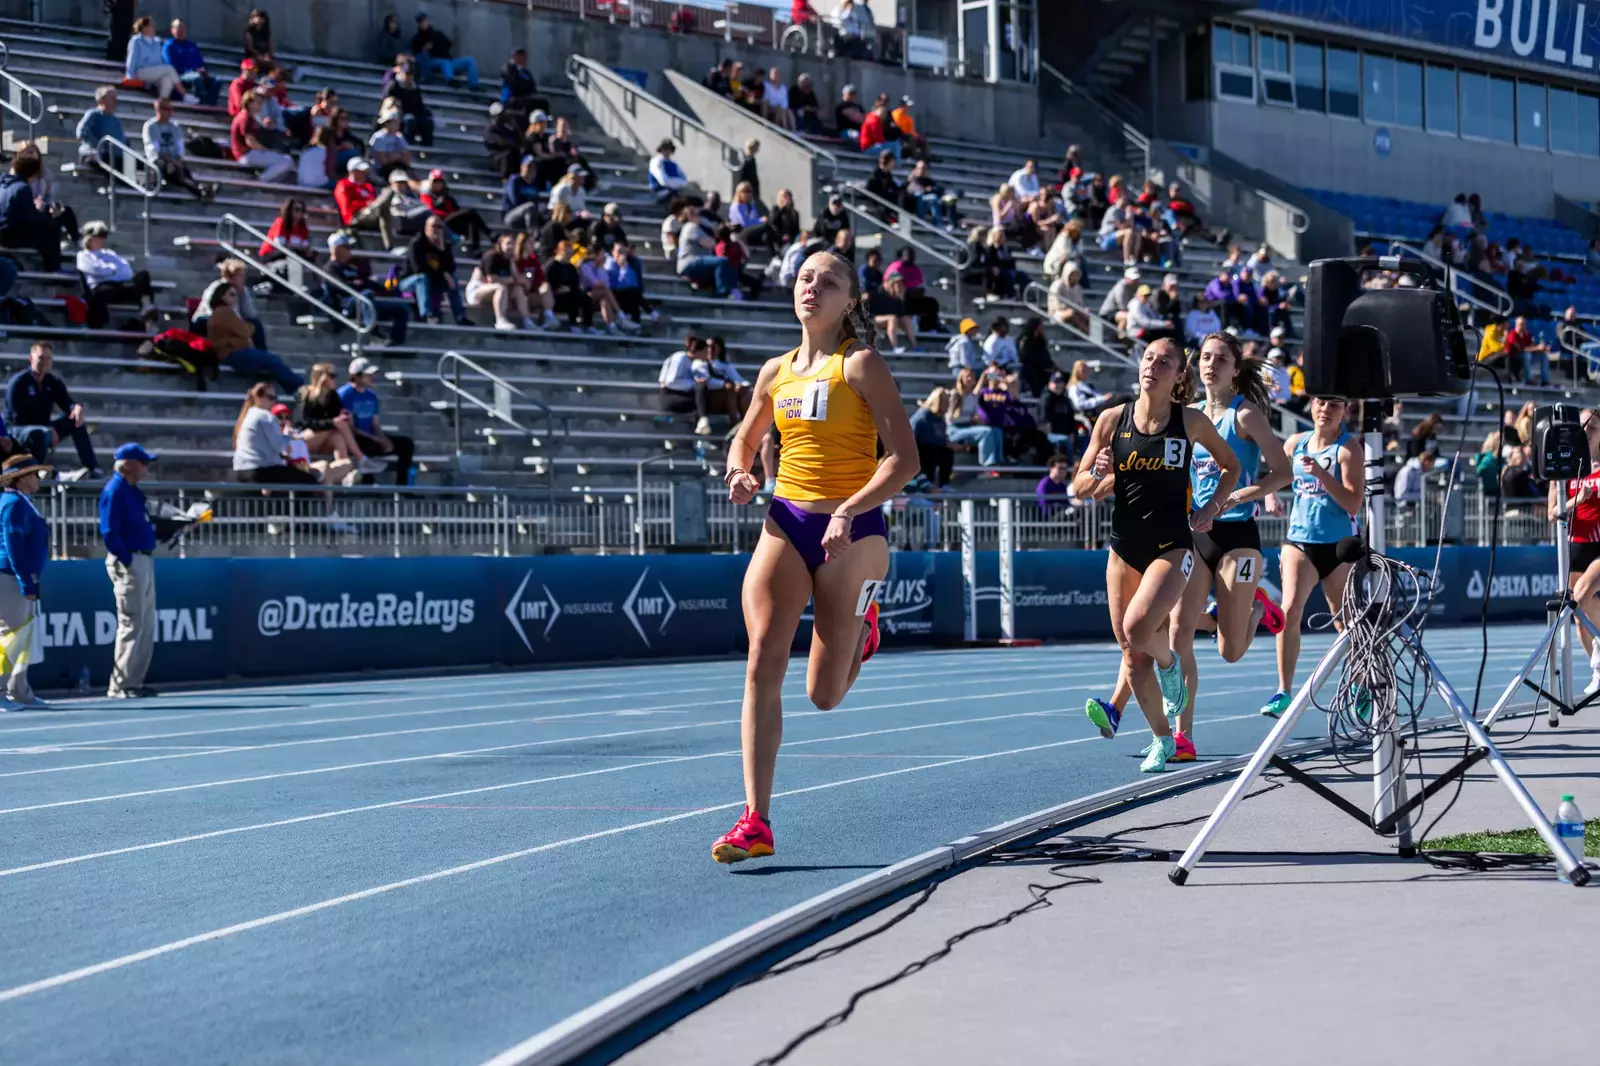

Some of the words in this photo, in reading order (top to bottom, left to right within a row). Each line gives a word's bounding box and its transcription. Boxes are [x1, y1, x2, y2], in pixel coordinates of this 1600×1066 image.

[777, 398, 803, 409] NORTH
[809, 385, 821, 418] 1
[785, 409, 803, 419] IOW
[1168, 440, 1183, 466] 3
[1183, 554, 1193, 578] 3
[1238, 558, 1252, 581] 4
[863, 582, 877, 614] 1
[875, 579, 927, 604] ELAYS
[1013, 590, 1072, 606] Continental
[1073, 589, 1094, 605] Tour
[1489, 576, 1529, 598] DELTA
[257, 591, 475, 637] @DrakeRelays
[520, 601, 549, 620] IMT
[563, 602, 614, 614] INSURANCE
[637, 597, 665, 616] IMT
[678, 598, 729, 610] INSURANCE
[39, 611, 89, 647] LTA
